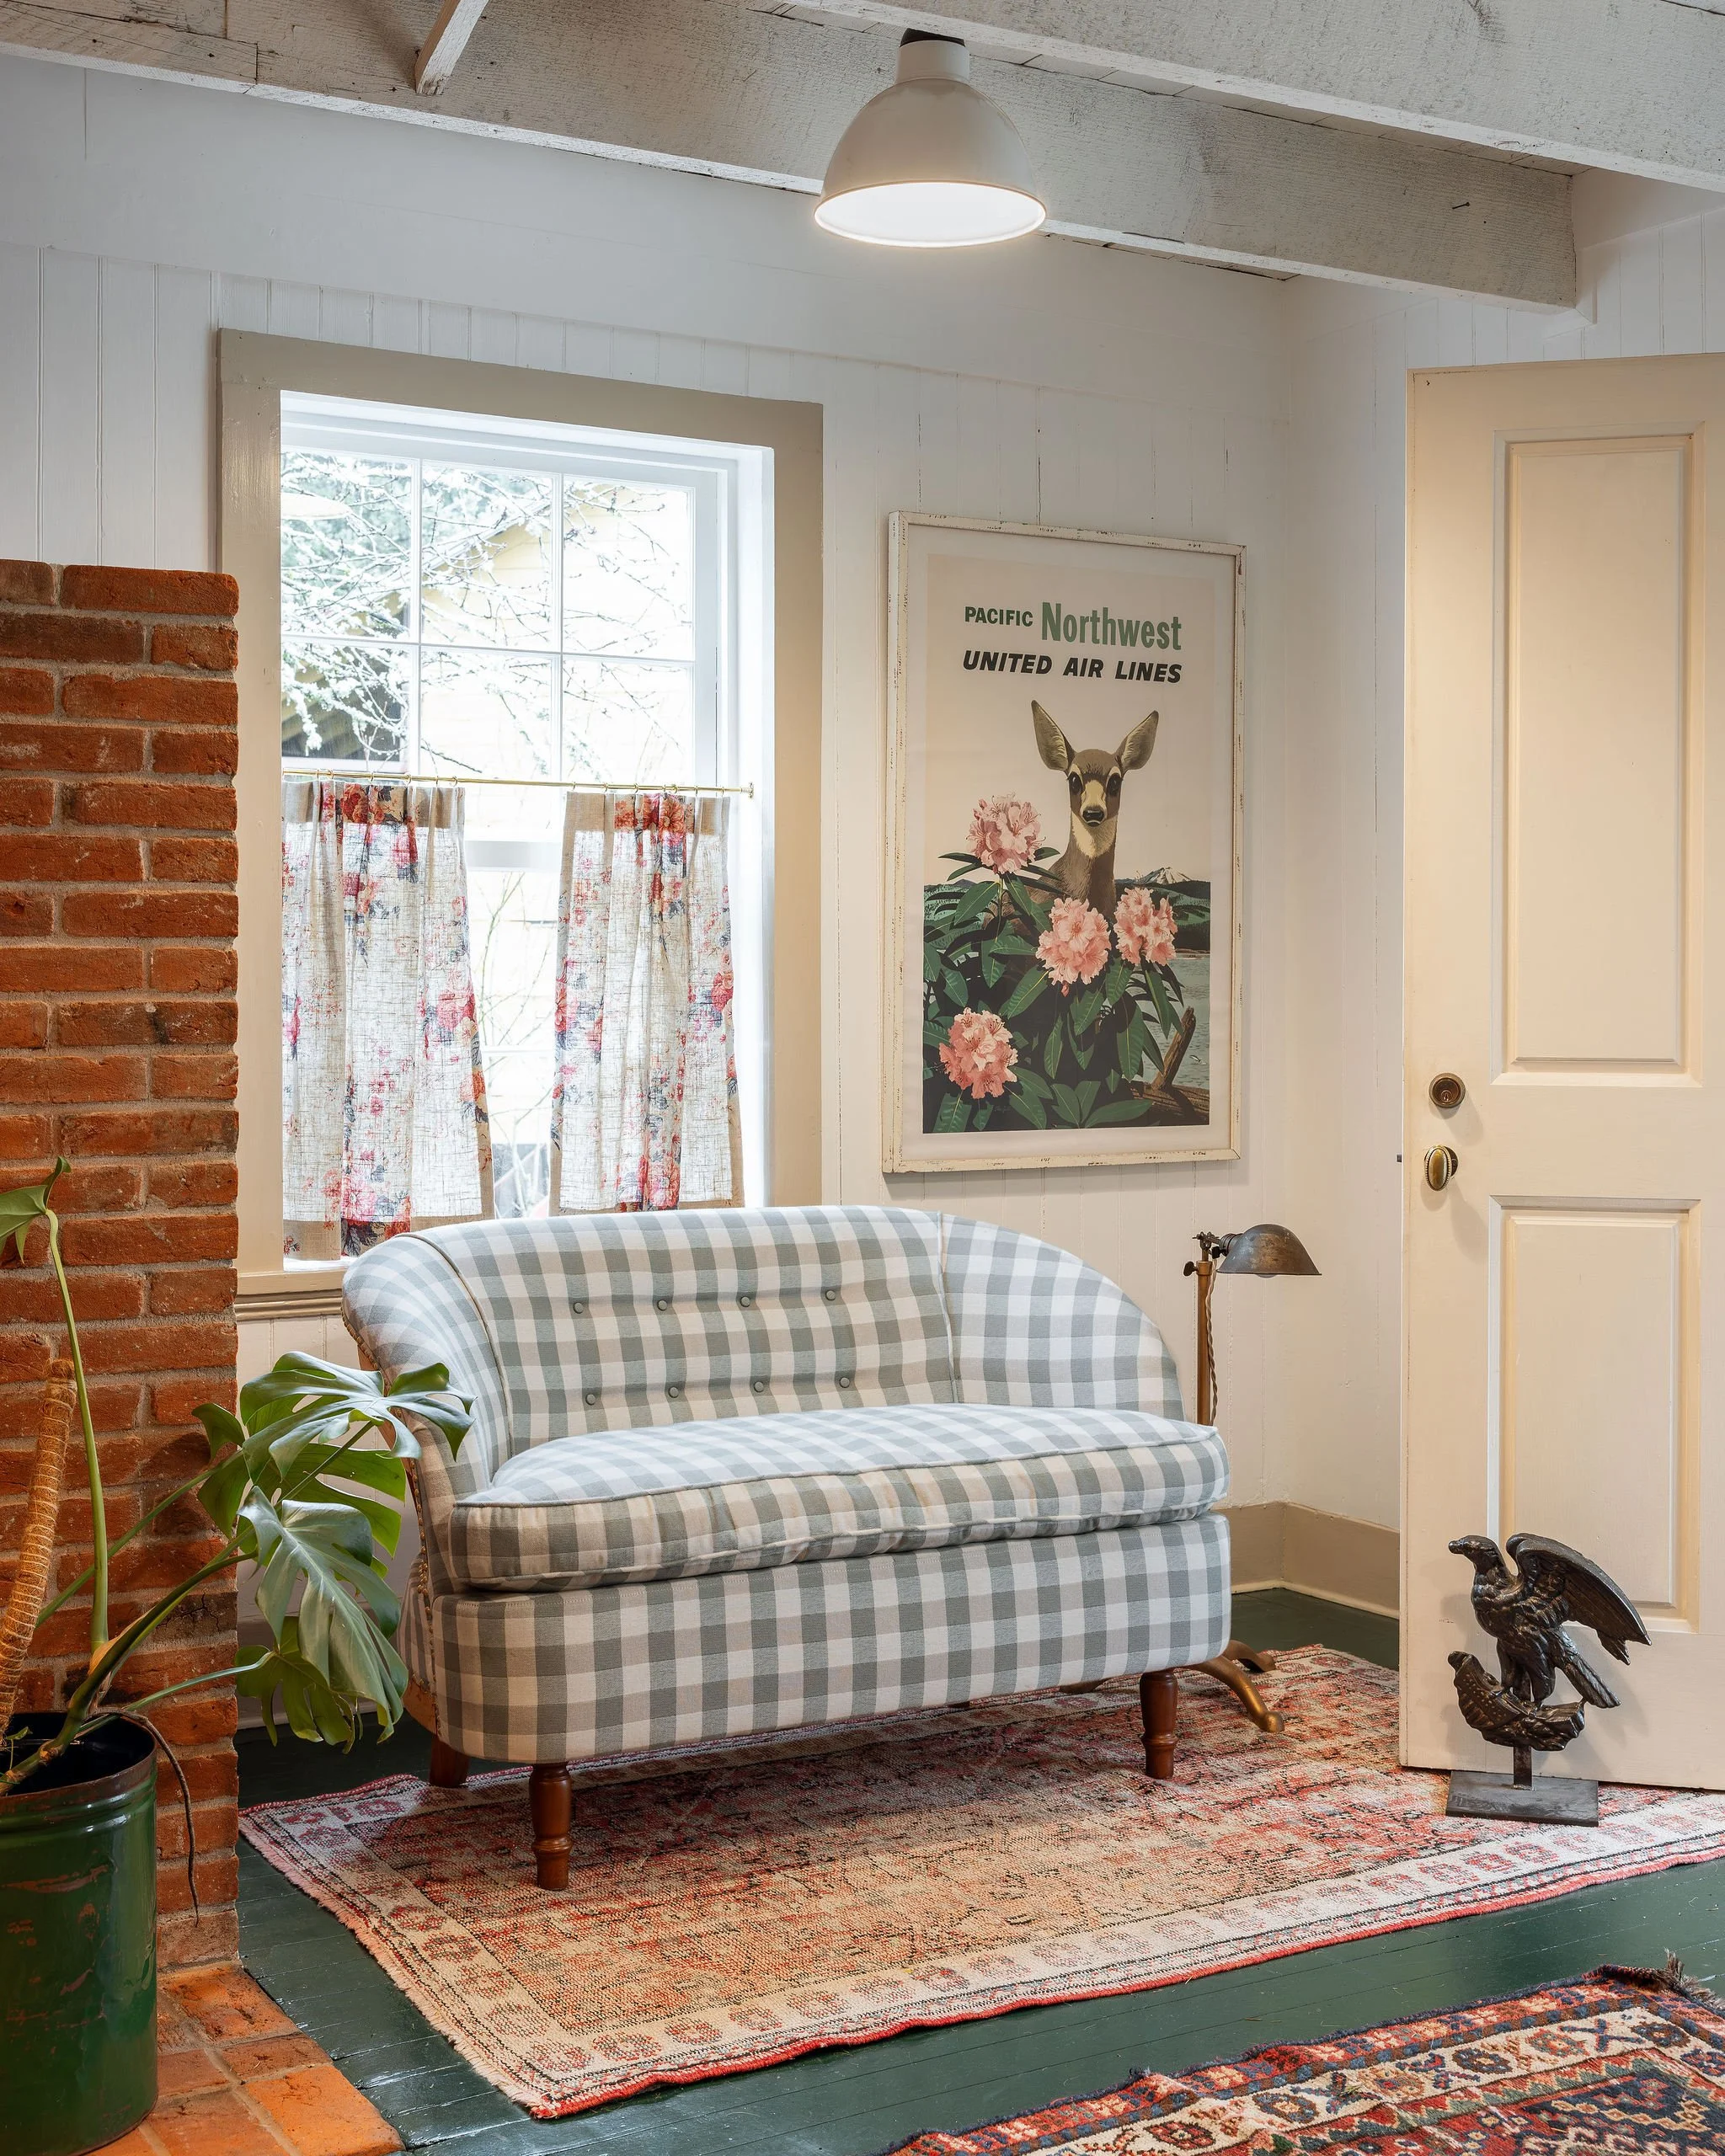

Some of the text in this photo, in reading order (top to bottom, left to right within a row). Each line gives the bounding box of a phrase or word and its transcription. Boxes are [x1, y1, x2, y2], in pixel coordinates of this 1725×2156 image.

[964, 601, 1182, 651] PACIFIC Northwest
[963, 650, 1183, 684] UNITED AIR LINES
